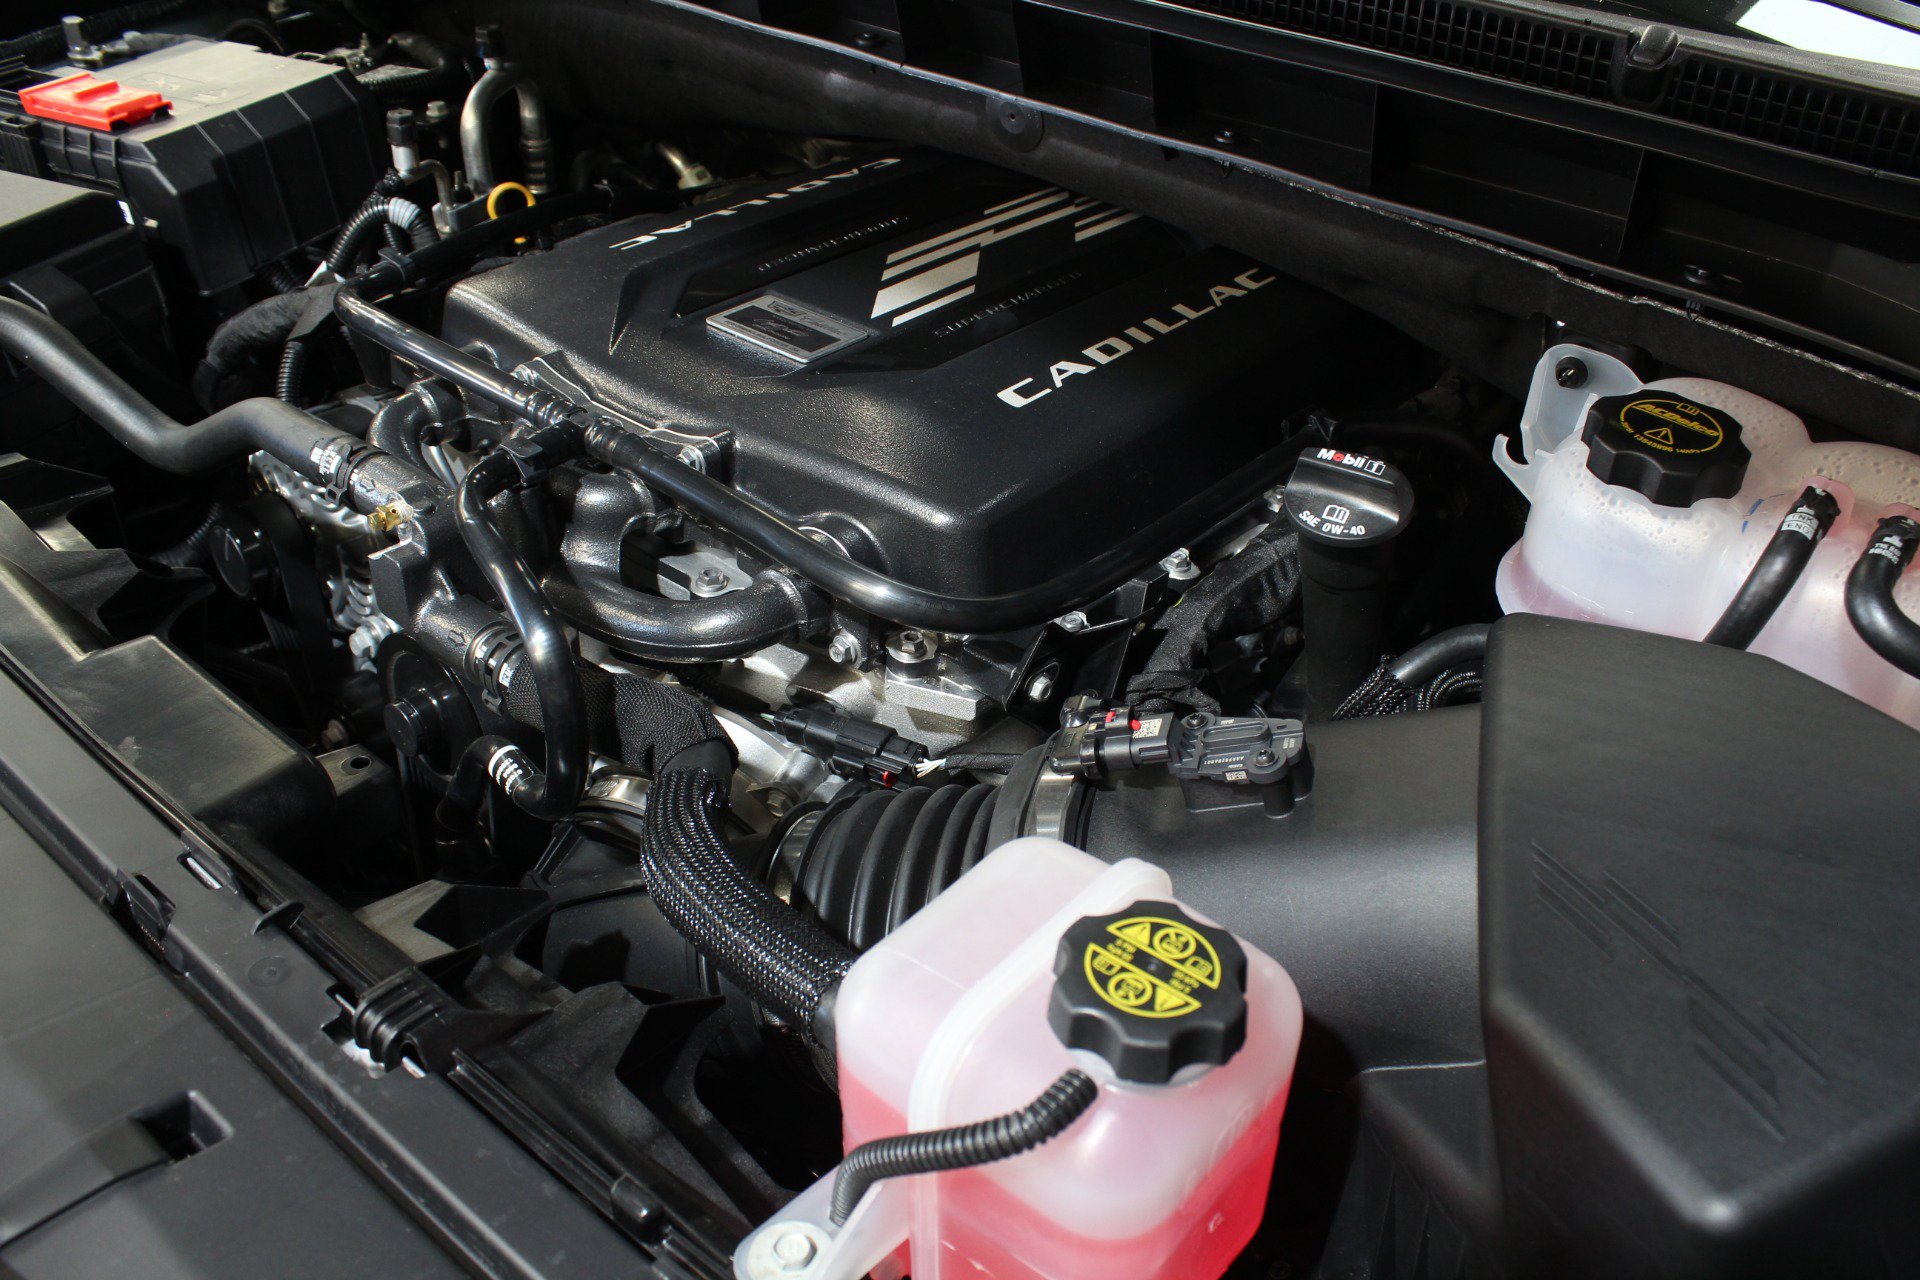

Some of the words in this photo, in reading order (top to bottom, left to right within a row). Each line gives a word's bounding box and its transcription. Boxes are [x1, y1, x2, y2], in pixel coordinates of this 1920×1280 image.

[608, 158, 901, 250] CADILLAC
[997, 268, 1276, 408] CADILLAC
[1632, 403, 1719, 437] ACDelco
[1316, 448, 1369, 469] Mobil
[1298, 510, 1322, 528] SAE
[1321, 522, 1366, 536] 0W-40
